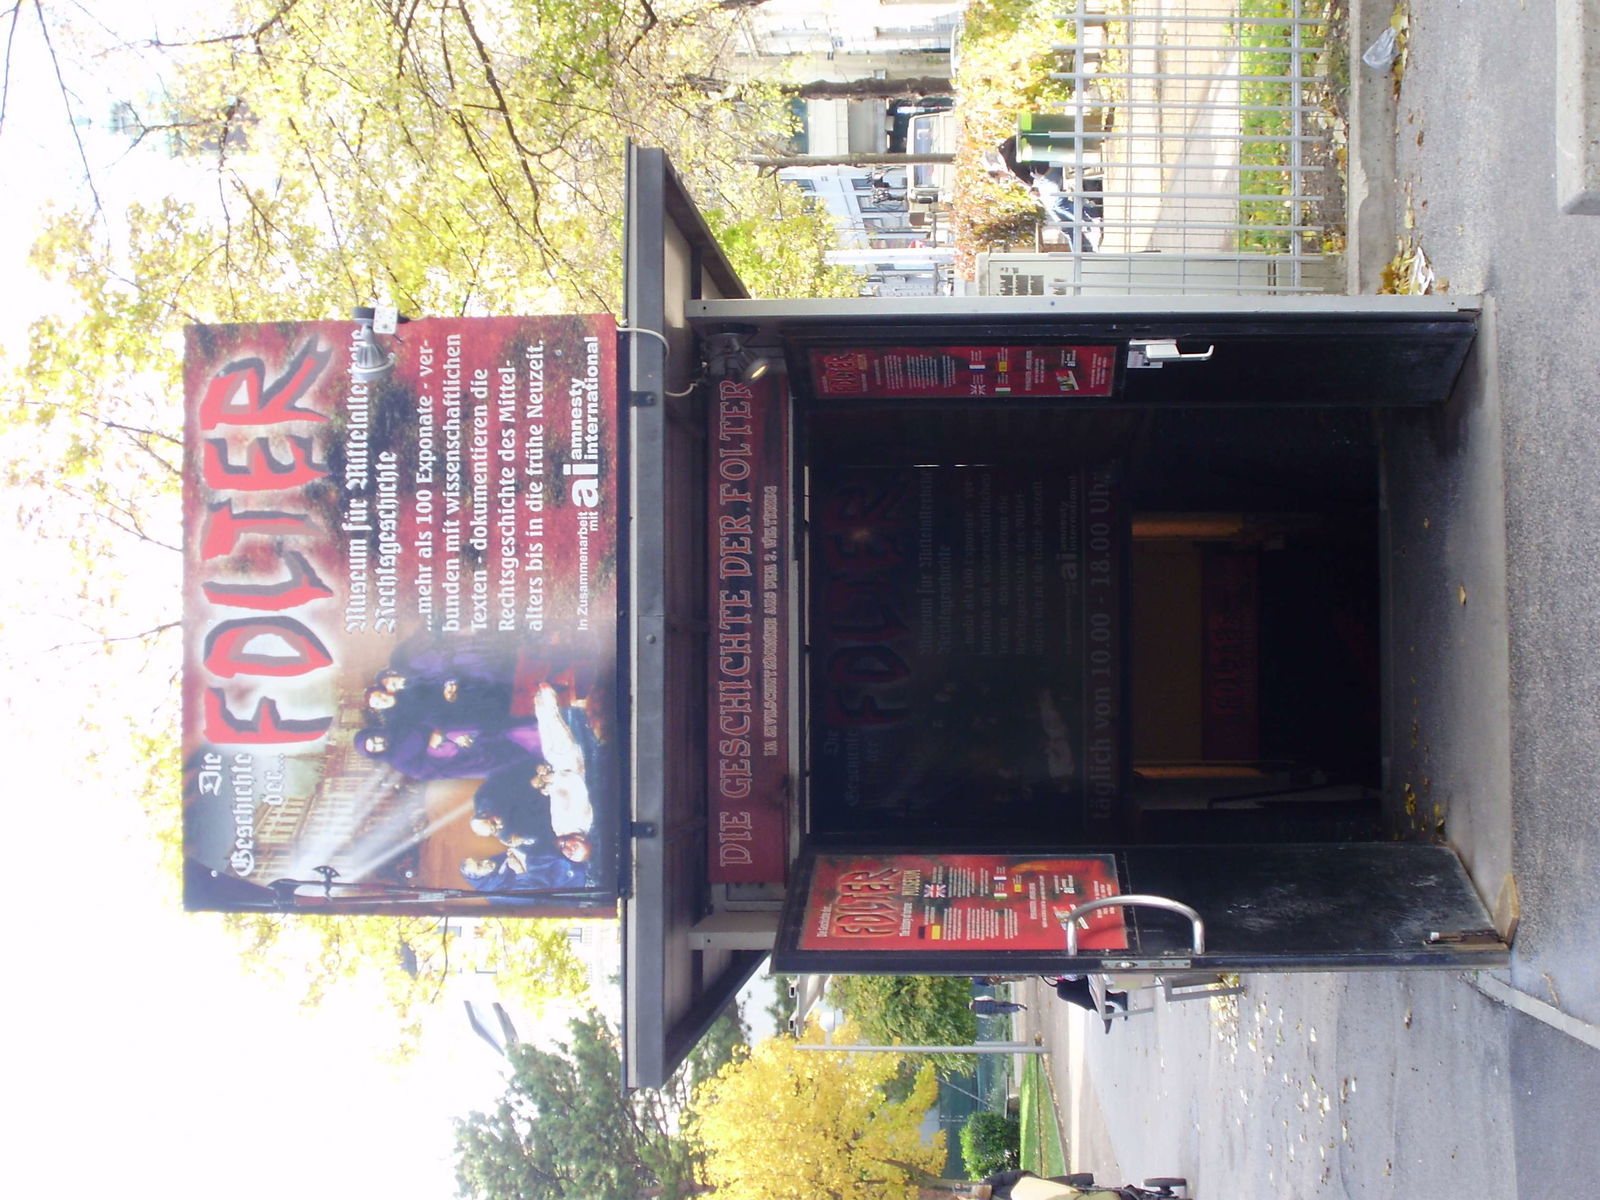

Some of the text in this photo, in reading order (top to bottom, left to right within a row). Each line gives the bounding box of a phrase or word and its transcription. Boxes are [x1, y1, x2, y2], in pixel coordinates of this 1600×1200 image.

[419, 339, 433, 376] ver-
[470, 368, 488, 399] die
[569, 377, 587, 460] amnesty
[584, 335, 599, 460] international
[415, 395, 437, 483] Exponate
[341, 330, 374, 633] Museum für Mittelalterhe
[415, 489, 433, 525] 100
[442, 334, 461, 631] bunden mit wissenschaftlichen
[469, 404, 488, 550] dokumentieren
[498, 360, 519, 631] Rechtsgeschichte des Mittel-
[526, 339, 544, 631] alters bis in die frühe Neuzeit.
[563, 463, 599, 507] ai
[199, 334, 334, 744] FOLTER
[374, 451, 401, 633] Rechtsgeschichte
[415, 531, 433, 559] als
[588, 510, 599, 531] mit
[1089, 522, 1111, 587] 18.00
[415, 563, 433, 631] ...mehr
[470, 570, 487, 631] Texten
[577, 510, 589, 631] In Zusammenarbeit
[1056, 553, 1077, 580] ai
[718, 379, 752, 867] DIE GESCHICHTE DER FOLTER
[821, 479, 912, 725] FOLTER
[1089, 612, 1111, 677] 10.00
[1094, 686, 1111, 730] von
[199, 753, 222, 796] Die
[262, 753, 284, 805] der...
[1088, 737, 1116, 819] täglich
[230, 753, 255, 876] Geschichte
[832, 868, 899, 938] FOLTER
[901, 869, 921, 896] MUSEUM
